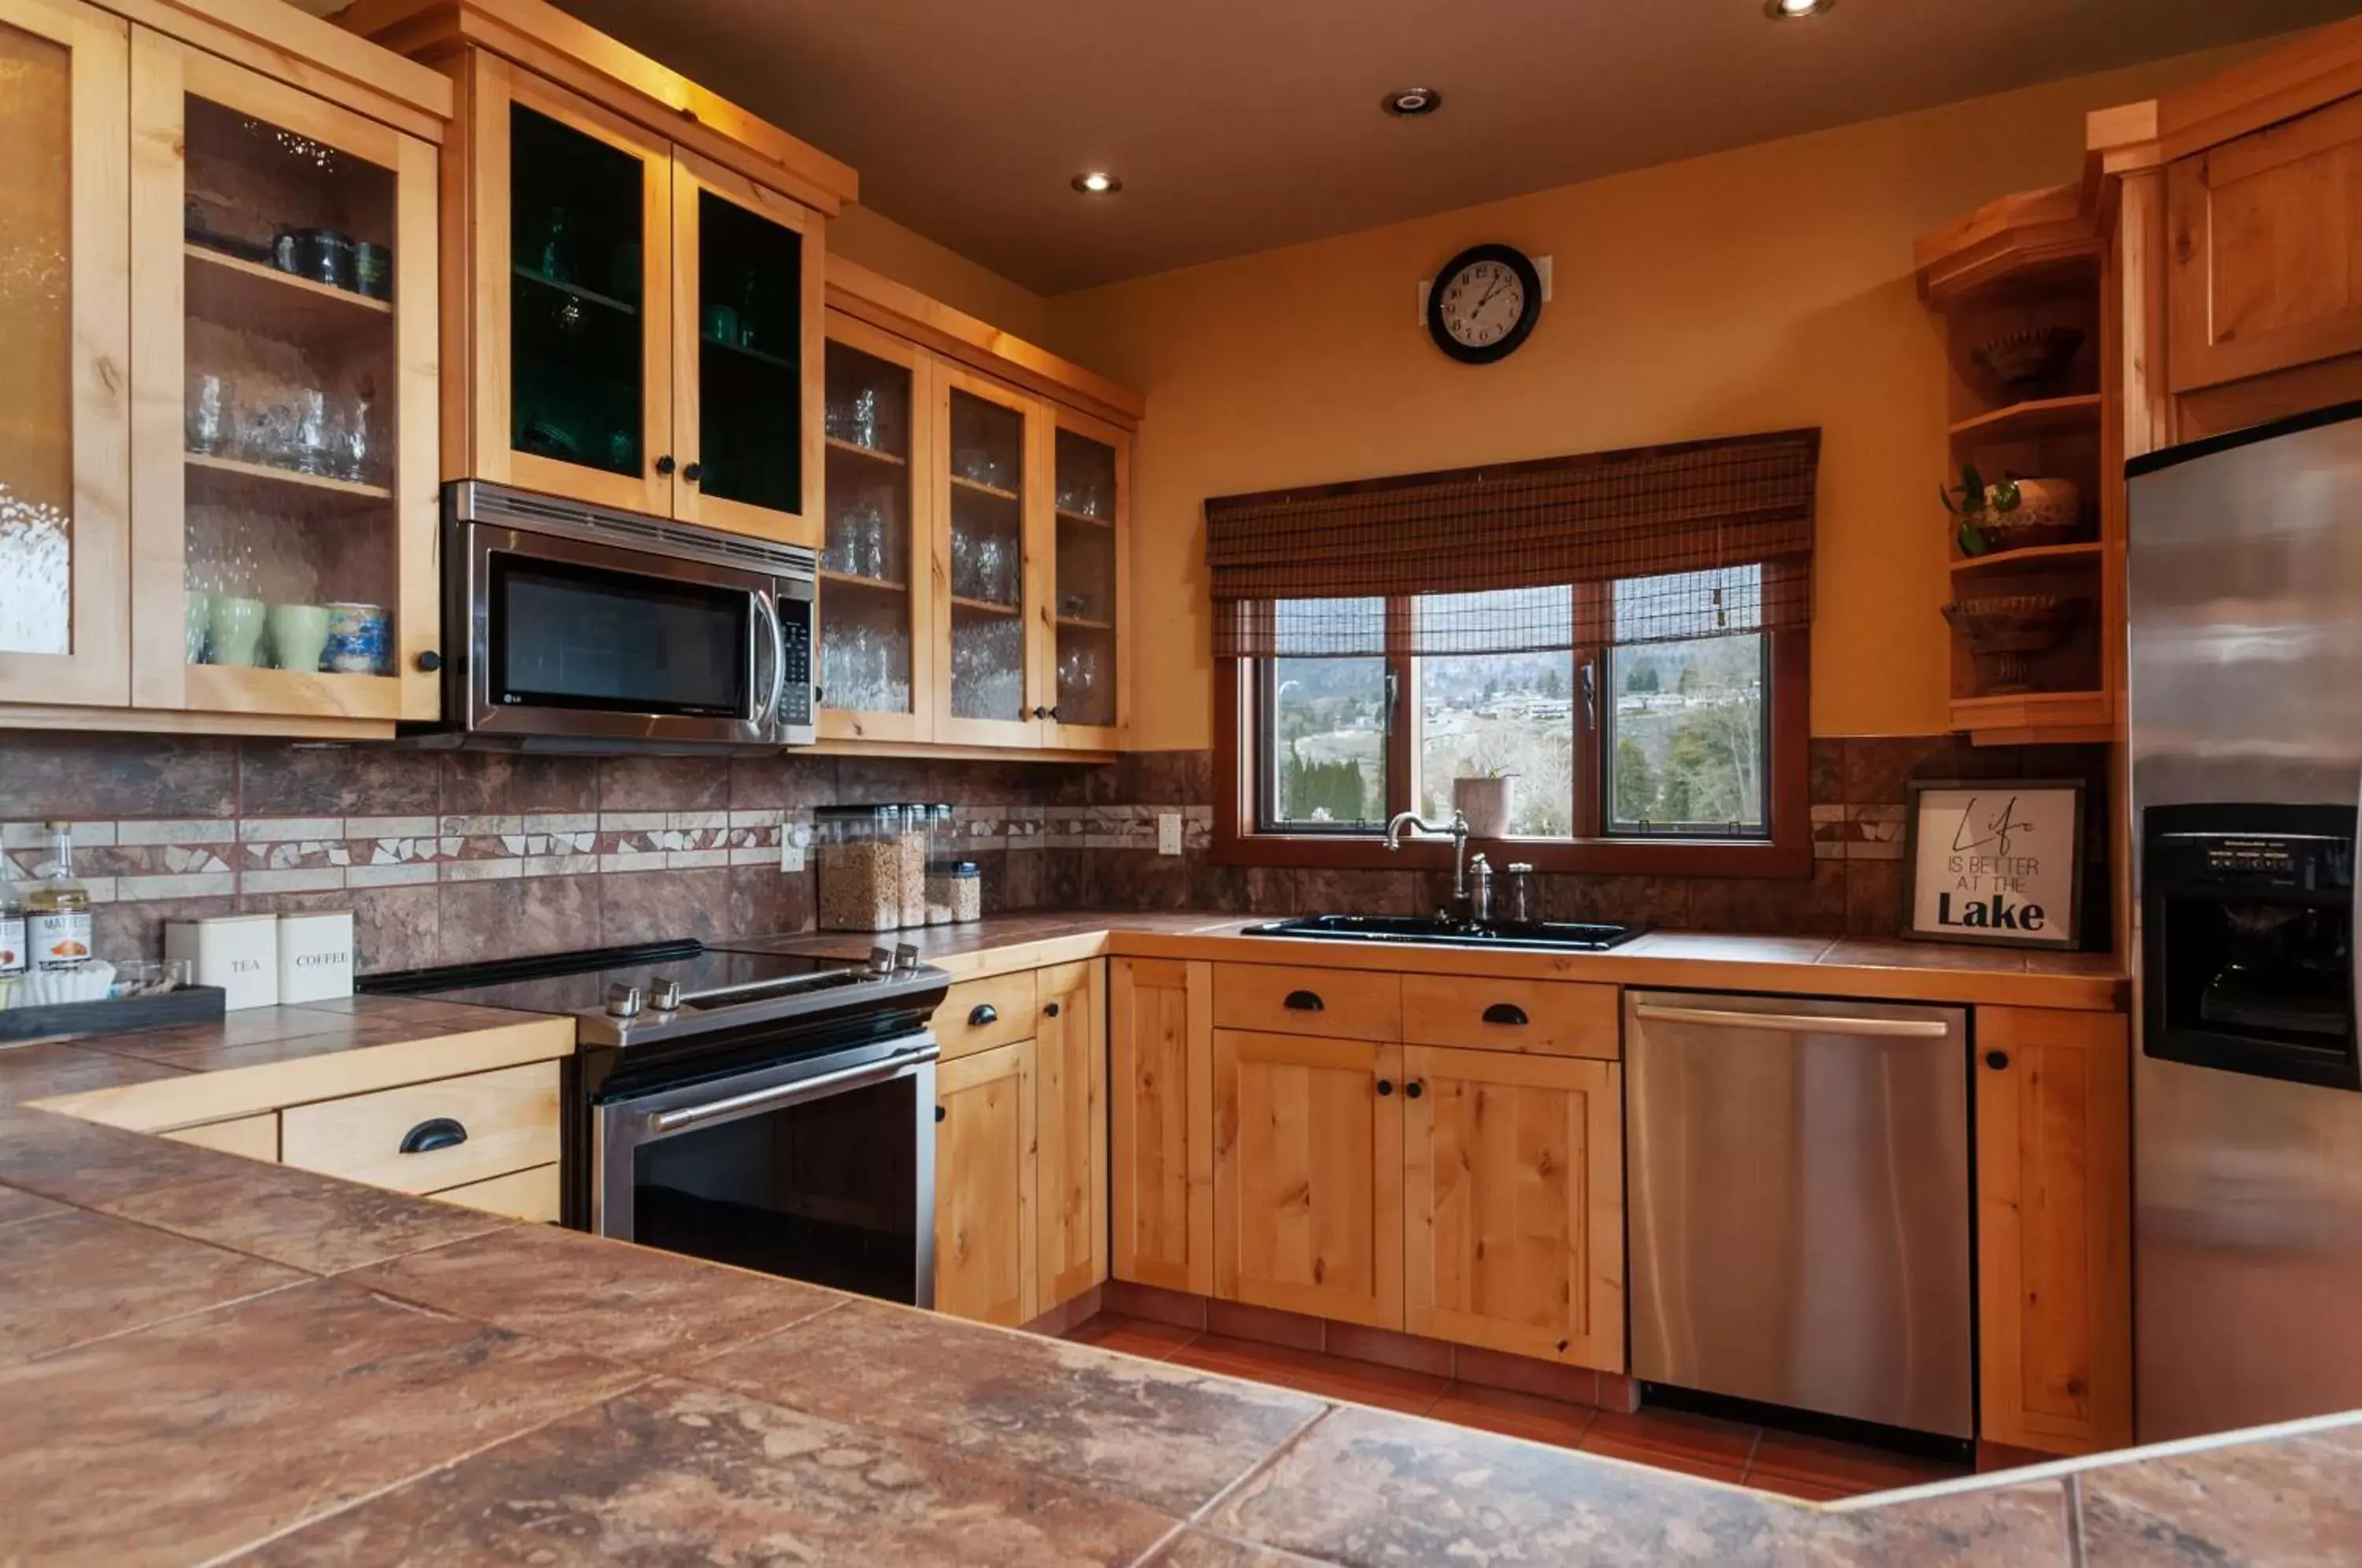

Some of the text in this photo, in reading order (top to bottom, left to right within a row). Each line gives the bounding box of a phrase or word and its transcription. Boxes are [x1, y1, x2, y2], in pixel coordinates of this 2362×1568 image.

[1461, 273, 1470, 284] 11
[1476, 267, 1487, 278] 12
[1451, 288, 1463, 299] 10
[1952, 796, 2037, 856] Life
[1948, 856, 2039, 875] IS BETTER
[1956, 875, 2027, 893] AT THE
[1938, 892, 2045, 931] Lake
[231, 960, 260, 973] TEA
[296, 951, 349, 967] COFFEE
